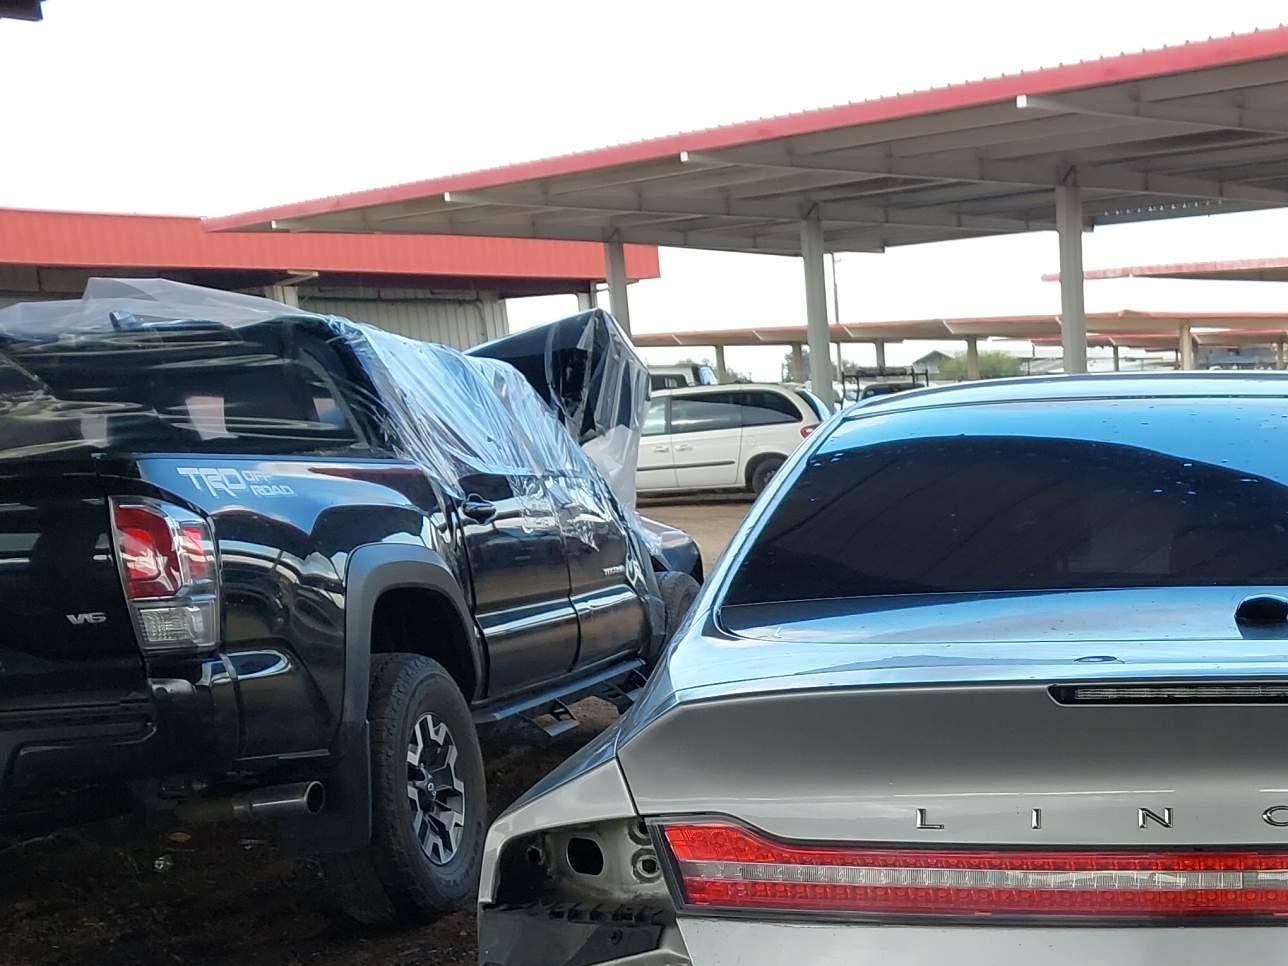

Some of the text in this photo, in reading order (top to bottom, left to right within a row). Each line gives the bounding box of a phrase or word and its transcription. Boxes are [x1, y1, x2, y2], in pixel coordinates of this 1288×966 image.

[176, 467, 247, 497] TRD
[249, 485, 296, 496] ROAD
[65, 612, 107, 624] V6
